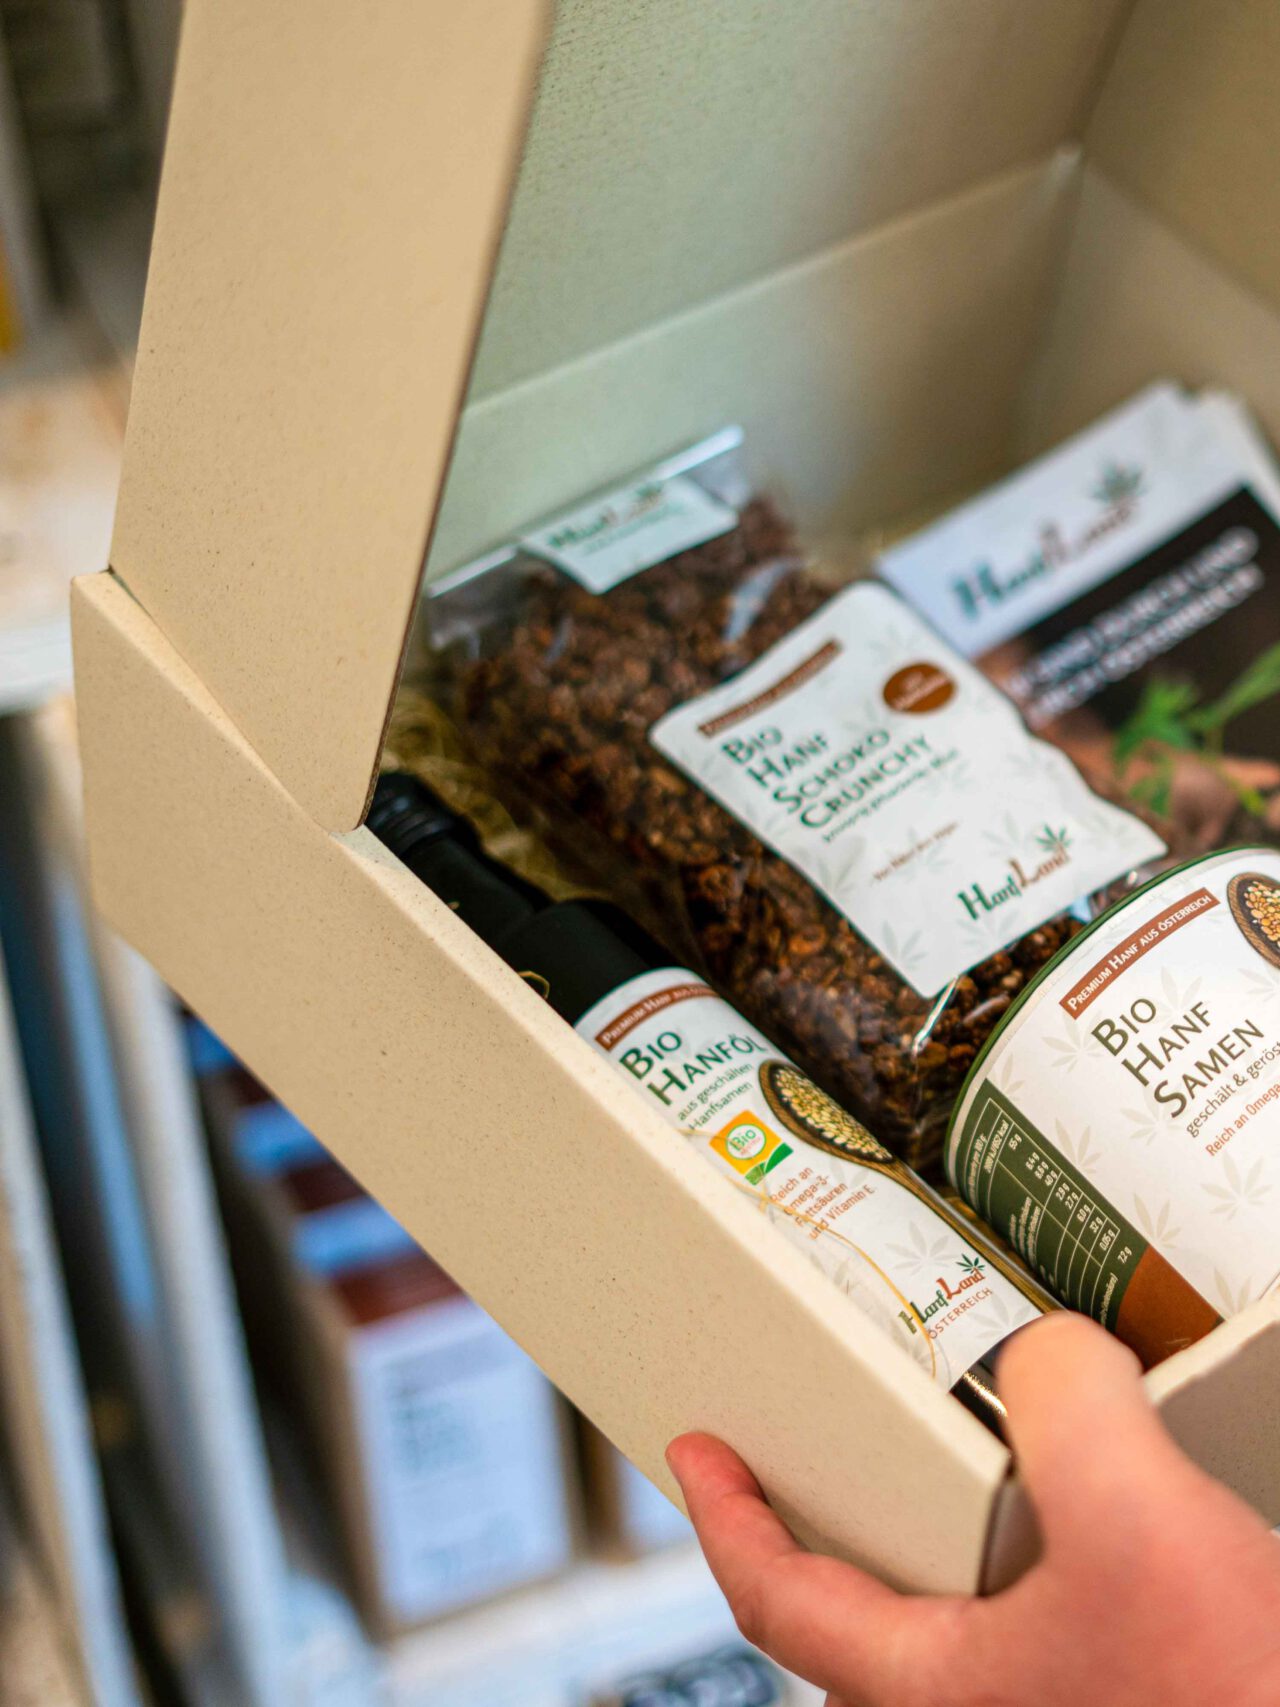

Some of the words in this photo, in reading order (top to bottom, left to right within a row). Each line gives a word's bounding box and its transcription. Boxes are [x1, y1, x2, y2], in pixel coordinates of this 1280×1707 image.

[721, 726, 783, 765] BIO
[746, 732, 831, 788] HANF
[773, 728, 891, 815] SCHOKO
[799, 733, 932, 829] CRUNCHY
[1067, 967, 1113, 1011] PREMIUM
[1108, 944, 1140, 970] HANF
[1139, 930, 1159, 947] AUS
[1157, 895, 1213, 931] ÖSTERREICH
[618, 1031, 683, 1080] BIO
[1091, 998, 1157, 1057] BIO
[1121, 1001, 1215, 1087] HANF
[646, 1033, 769, 1106] HANFÖL
[677, 1101, 698, 1122] aus
[696, 1062, 755, 1104] geschälten
[1153, 1018, 1265, 1119] SAMEN
[687, 1082, 754, 1132] Hanfsamen
[1186, 1083, 1237, 1138] geschält
[1233, 1073, 1249, 1087] &
[1205, 1124, 1236, 1157] Reich
[1234, 1114, 1249, 1129] an
[769, 1177, 799, 1204] Reich
[799, 1167, 814, 1181] an
[794, 1182, 849, 1228] Fttsäuren
[825, 1190, 867, 1221] Vitamin
[927, 1287, 993, 1340] ÖSTERREICH
